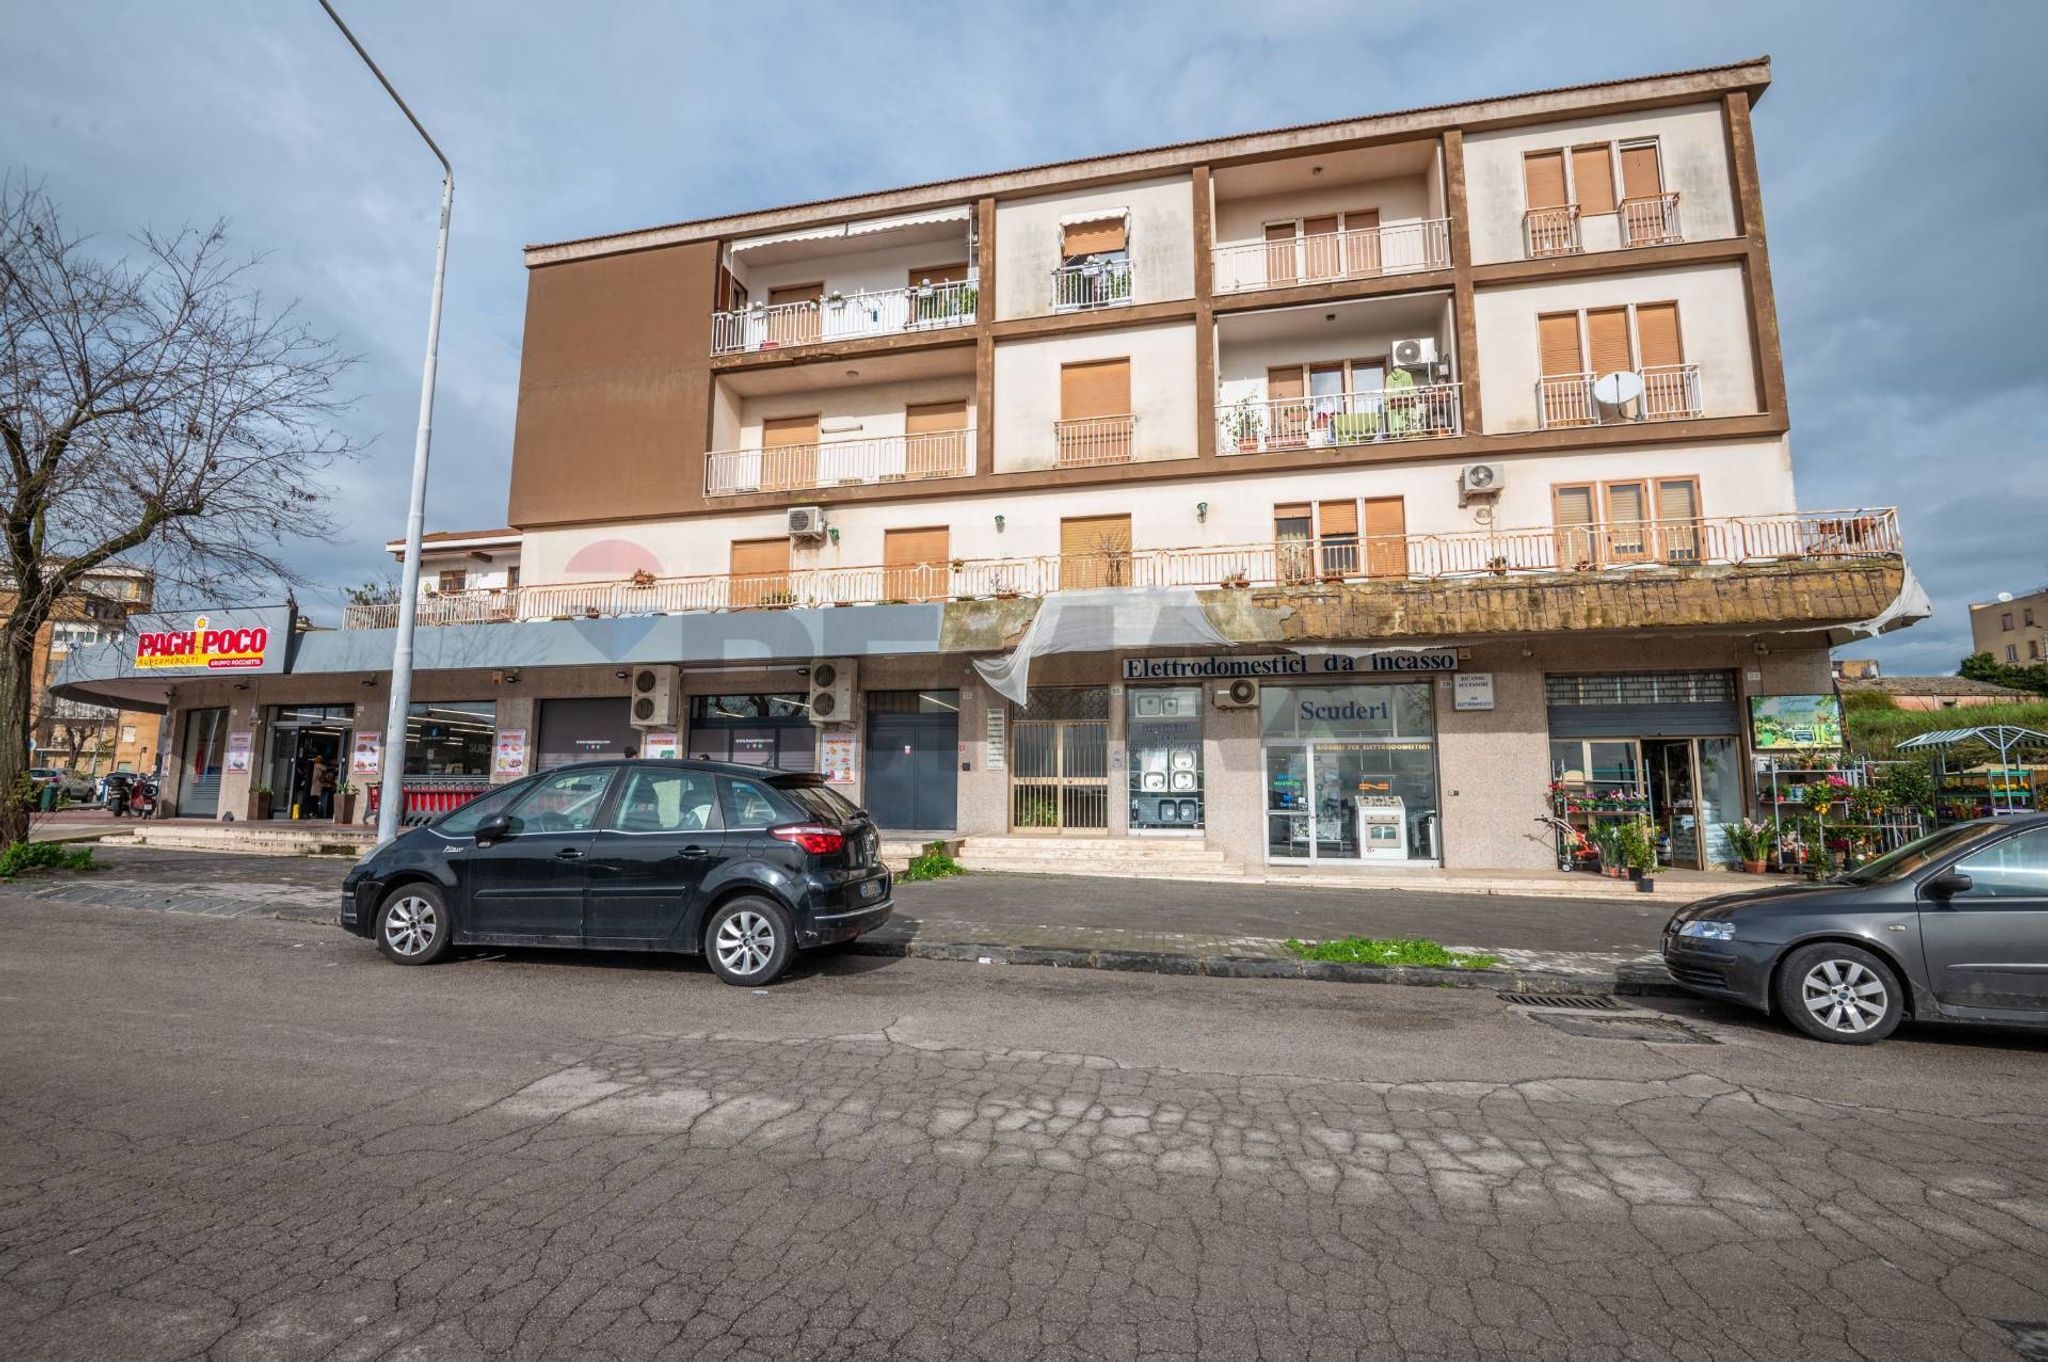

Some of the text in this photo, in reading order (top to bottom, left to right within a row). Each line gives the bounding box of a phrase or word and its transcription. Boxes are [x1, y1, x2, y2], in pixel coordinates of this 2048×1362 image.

[1128, 653, 1454, 678] Elettrodomestici da incasso
[1301, 701, 1388, 721] Scuderi
